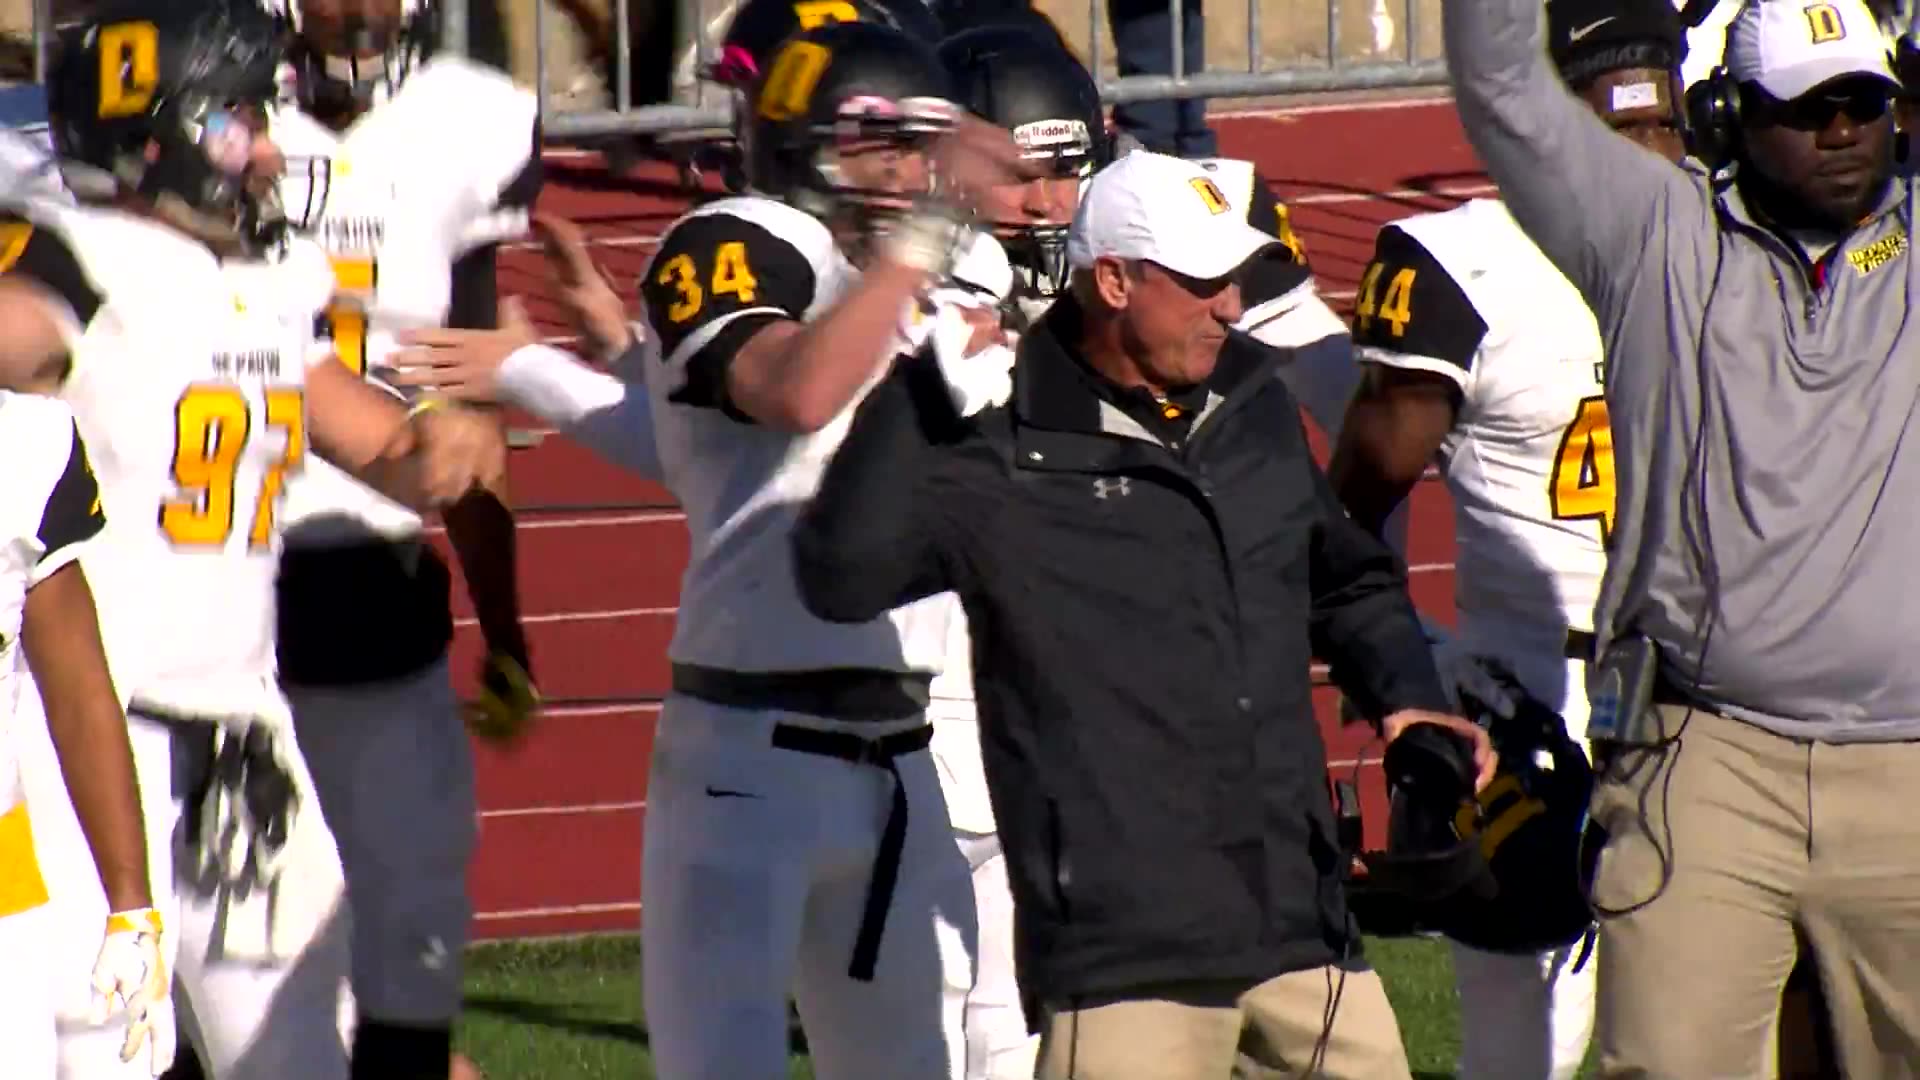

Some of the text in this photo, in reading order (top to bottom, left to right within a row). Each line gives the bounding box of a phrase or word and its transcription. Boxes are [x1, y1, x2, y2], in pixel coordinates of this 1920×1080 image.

[1803, 4, 1847, 45] D
[98, 20, 160, 118] D
[1188, 176, 1231, 215] D
[658, 242, 758, 323] 34
[1357, 262, 1417, 337] 44
[160, 381, 305, 554] 97
